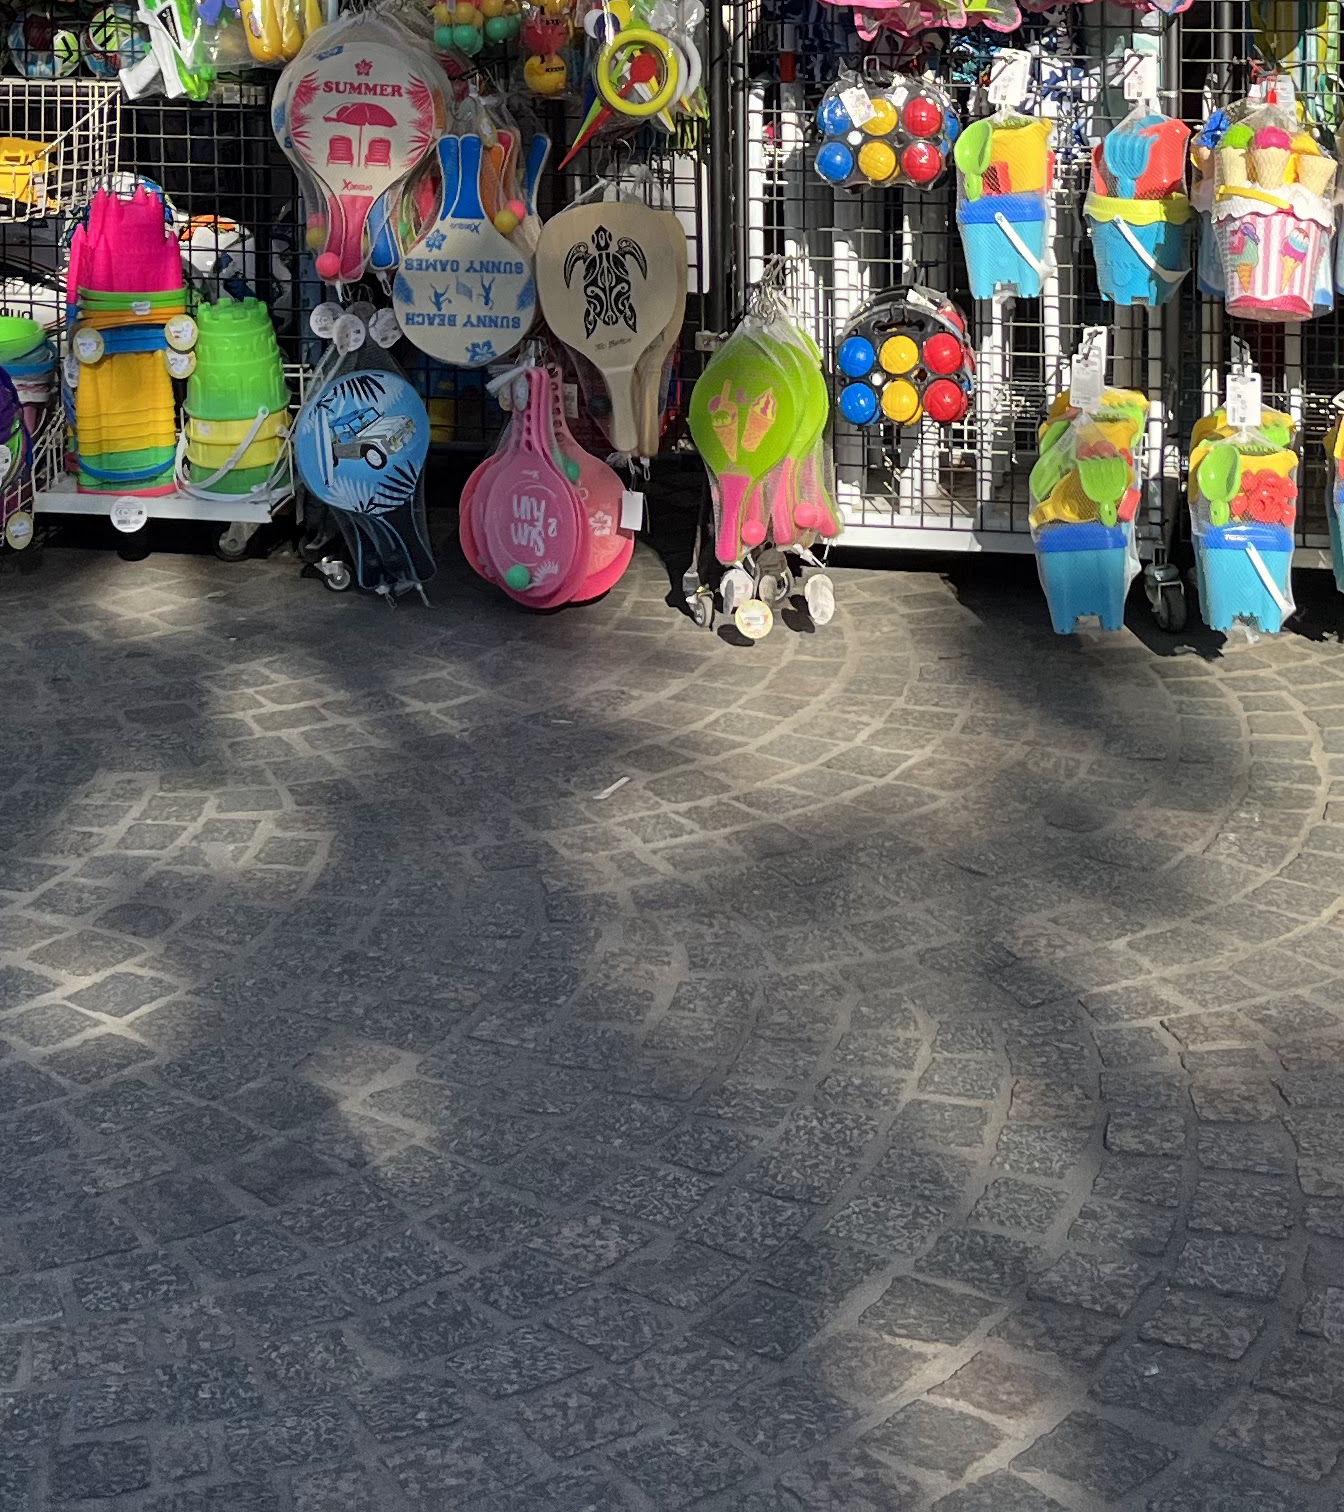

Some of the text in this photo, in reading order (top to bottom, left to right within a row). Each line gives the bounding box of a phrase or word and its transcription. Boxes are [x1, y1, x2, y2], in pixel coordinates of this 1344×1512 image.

[322, 80, 404, 98] SUMMER
[464, 259, 525, 275] SUNNY
[404, 312, 522, 329] SUNNY BEACH
